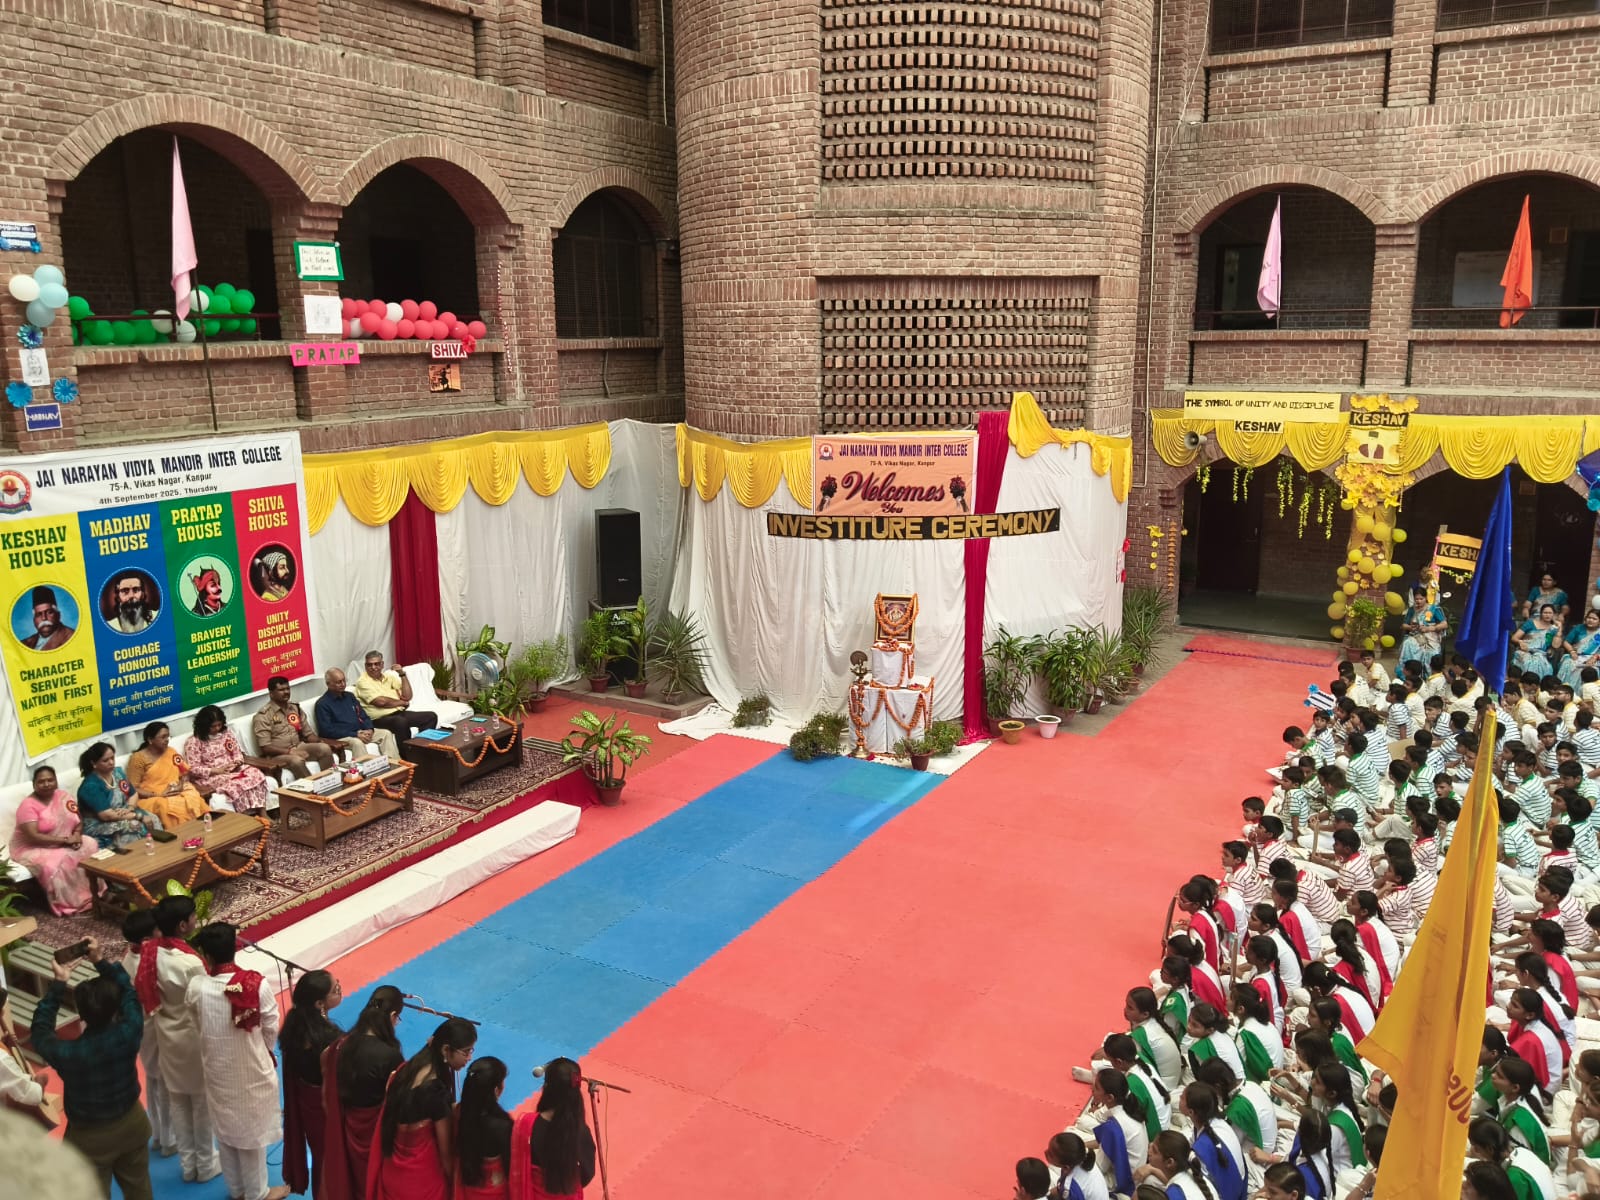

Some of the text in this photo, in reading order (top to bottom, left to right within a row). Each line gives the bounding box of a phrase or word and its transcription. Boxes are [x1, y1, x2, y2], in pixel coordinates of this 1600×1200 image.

[295, 348, 355, 361] PRATAP
[434, 344, 467, 357] SHIVA
[1185, 399, 1202, 407] THE
[1205, 399, 1233, 407] SYMBOL
[1246, 400, 1272, 408] UNITY
[1273, 400, 1288, 409] AND
[1289, 401, 1335, 410] DISCIPLINE
[1235, 421, 1282, 432] KESHAV
[1353, 412, 1406, 426] KESHAV
[839, 443, 968, 457] JAI NARAYAN VIDYA MANDIR INTER COLLEGE
[36, 469, 56, 489] JAI
[61, 462, 118, 486] NARAYAN
[122, 459, 156, 479] VIDYA
[160, 453, 204, 474] MANDIR
[207, 450, 237, 469] INTER
[241, 445, 283, 465] COLLEGE
[134, 478, 156, 490] Vikas
[158, 475, 184, 488] Nagar,
[186, 472, 213, 484] Kanpur
[841, 470, 946, 502] Welcomes
[98, 497, 112, 505] 4th
[114, 491, 159, 504] September
[185, 484, 218, 496] Thursday
[248, 495, 285, 514] SHIVA
[171, 503, 223, 526] PRATAP
[880, 502, 904, 514] You
[89, 513, 151, 538] MADHAV
[176, 521, 223, 543] HOUSE
[247, 511, 288, 532] HOUSE
[767, 509, 1056, 540] INVESTITURE CEREMONY
[0, 525, 67, 550] KESHAV
[98, 533, 149, 556] HOUSE
[8, 546, 66, 570] HOUSE
[266, 610, 289, 625] UNITY
[191, 624, 232, 644] BRAVERY
[257, 619, 300, 640] DISCIPLINE
[114, 641, 161, 661] COURAGE
[195, 637, 232, 655] JUSTICE
[257, 630, 302, 652] DEDICATION
[118, 655, 159, 674] HONOUR
[187, 647, 240, 670] LEADERSHIP
[20, 658, 85, 682] CHARACTER
[109, 664, 170, 690] PATRIOTISM
[30, 674, 78, 693] SERVICE
[20, 683, 93, 711] NATION FIRST
[54, 709, 67, 720] और
